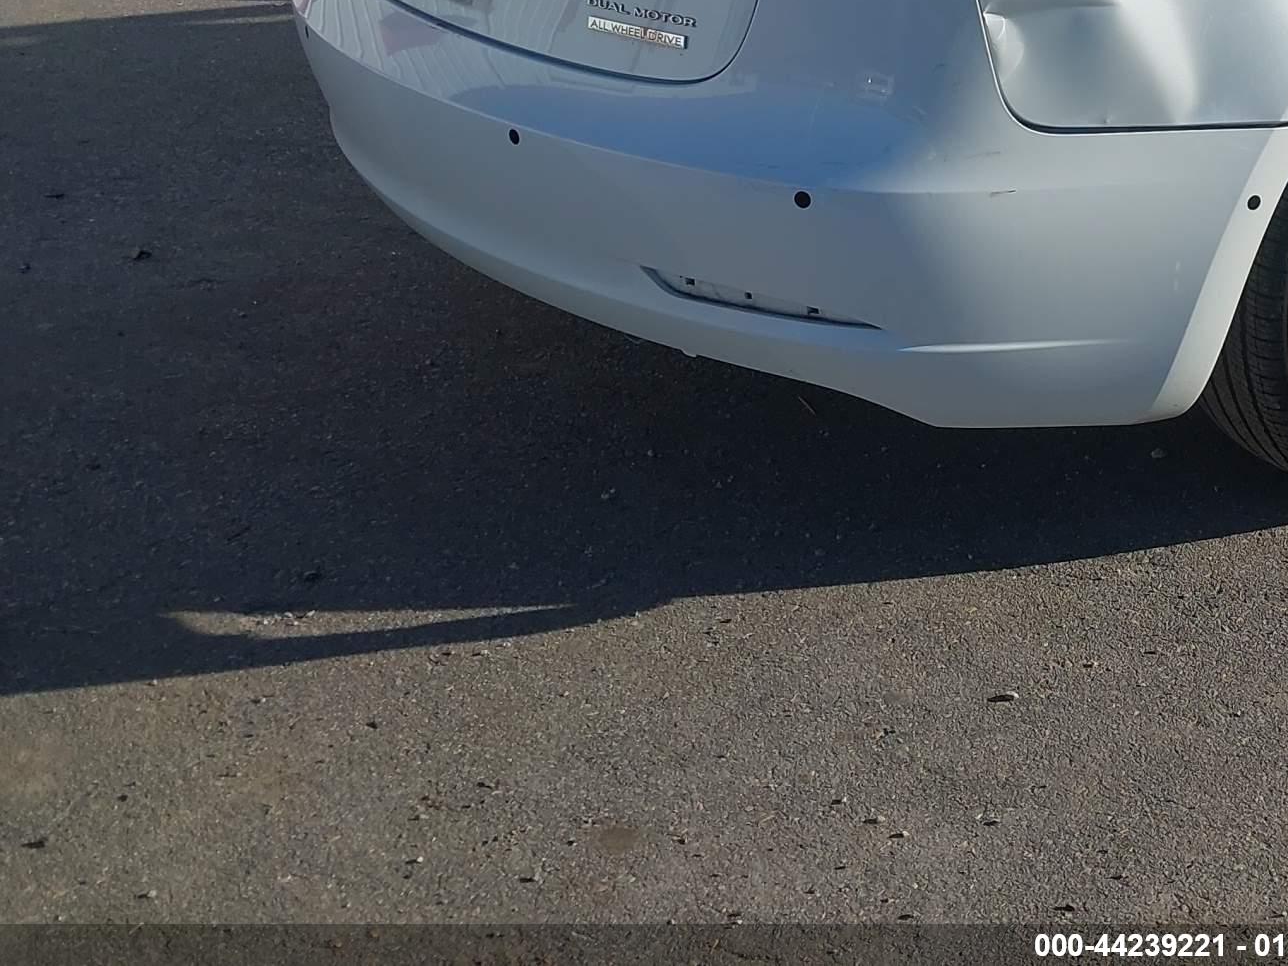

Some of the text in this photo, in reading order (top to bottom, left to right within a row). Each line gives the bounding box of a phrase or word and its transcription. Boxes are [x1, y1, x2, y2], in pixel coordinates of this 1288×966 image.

[633, 7, 697, 27] MOTOR
[590, 18, 682, 47] ALL WHEEL DRIVE
